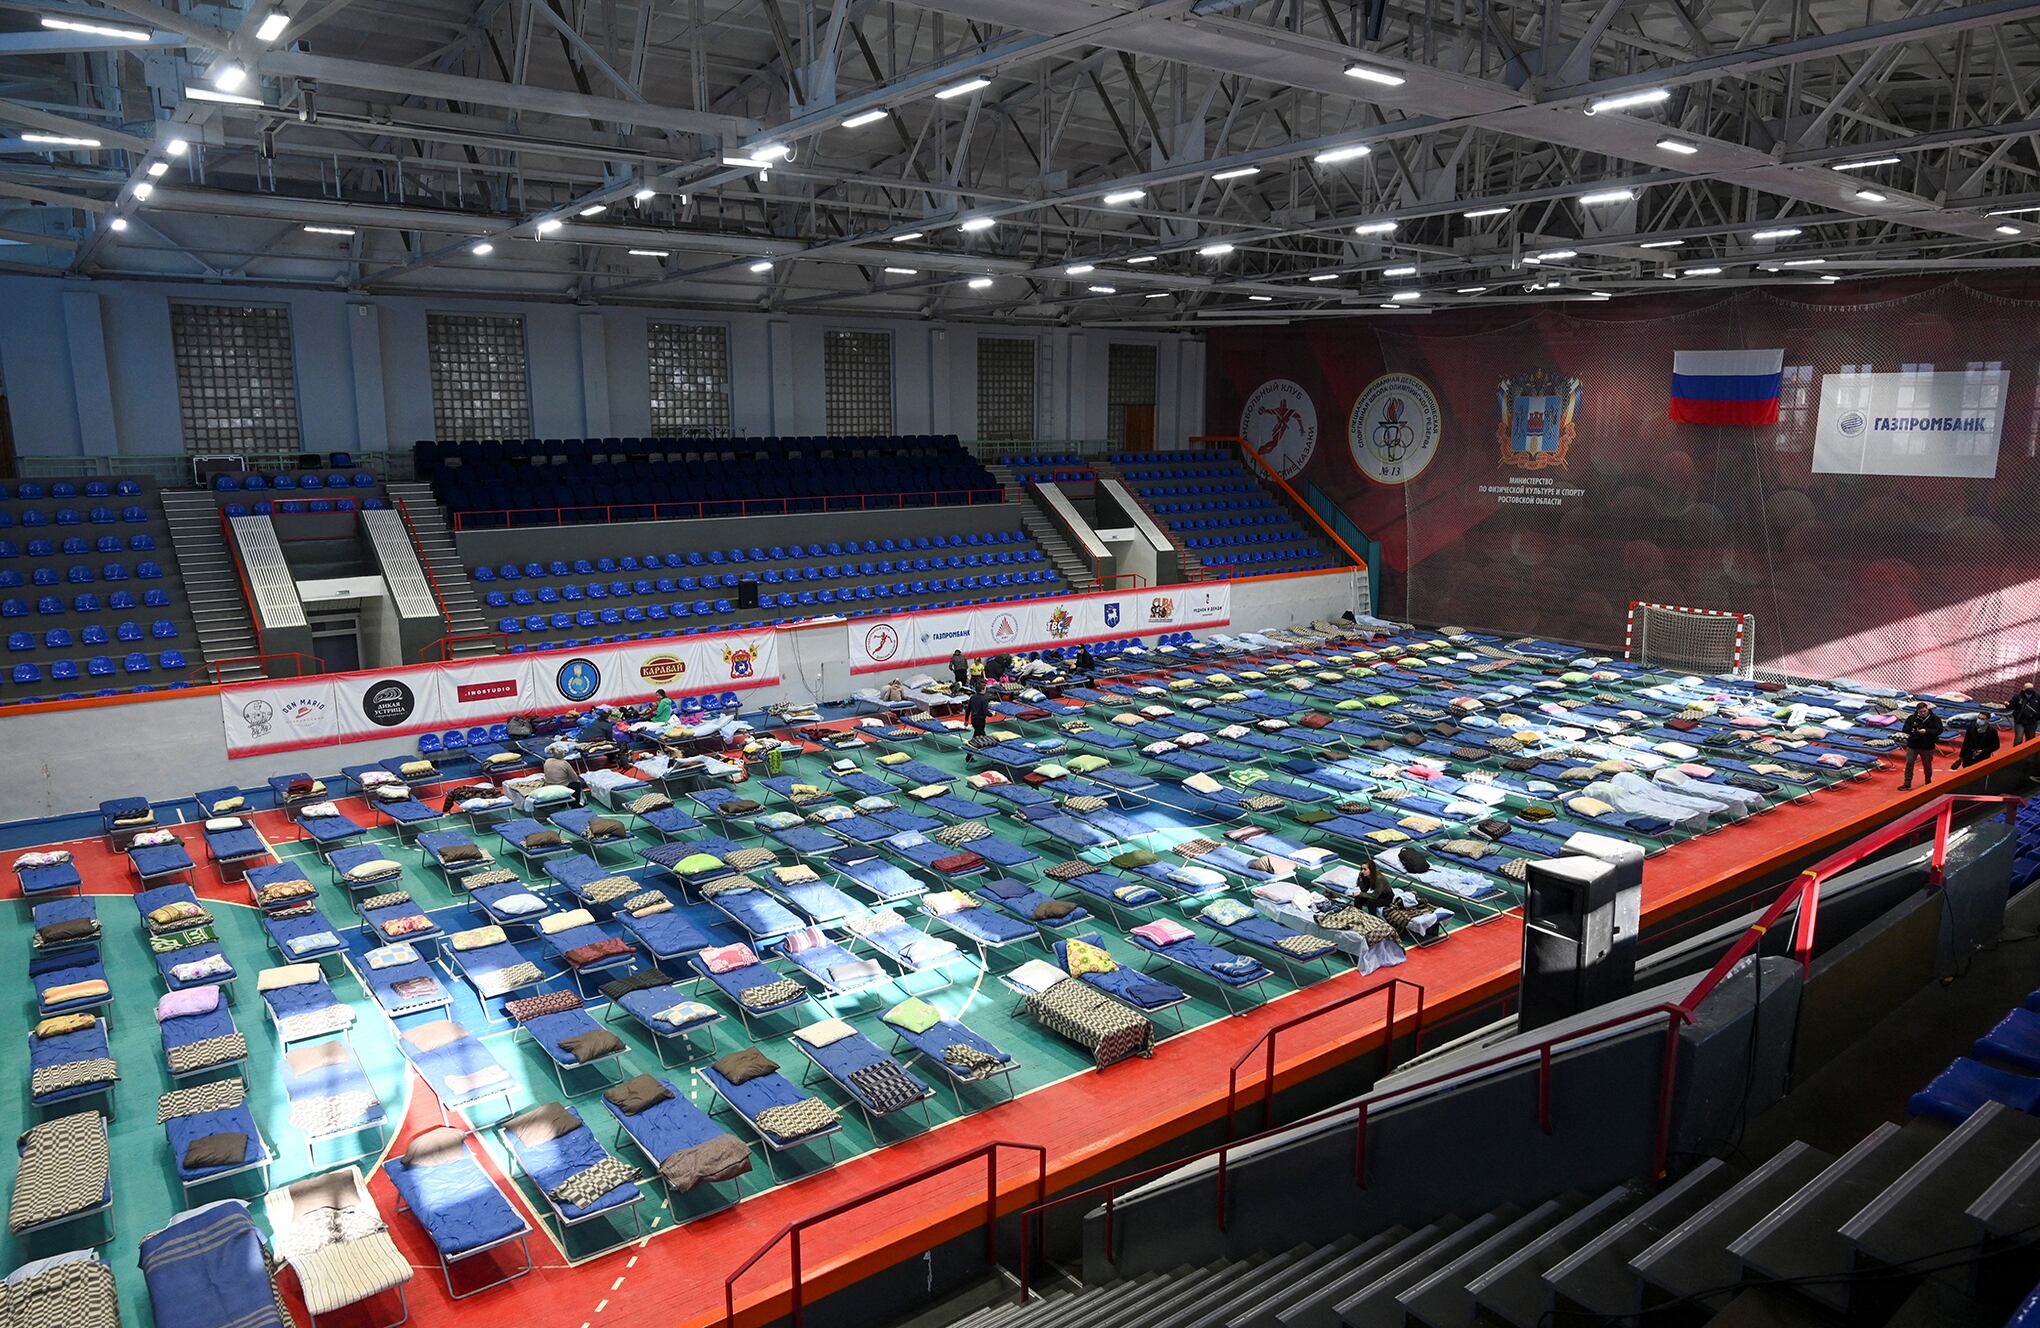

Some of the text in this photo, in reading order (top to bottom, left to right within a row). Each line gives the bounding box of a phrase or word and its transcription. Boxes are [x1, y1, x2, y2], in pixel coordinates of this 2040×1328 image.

[1242, 382, 1303, 441] АНДБОЛЬНЫЙ КЛУБ
[1351, 376, 1439, 434] СПЕЦИАЛИЗИРОВАННАЯ ДЕТСКО-ЮНОШЕСКАЯ
[1369, 386, 1388, 402] ШКОЛА
[1389, 384, 1430, 414] ОЛИМПИЙСКОГО
[1421, 417, 1431, 449] РЕЗЕРВА
[1874, 417, 1985, 431] ГАЗПРОМБАНК
[1297, 426, 1314, 468] КАЗАКИ
[1379, 466, 1401, 477] № 13
[1479, 485, 1487, 493] ПО
[1488, 485, 1524, 494] ФИЗИЧЕСКОЙ
[1525, 487, 1554, 495] КУЛЬТУРЕ
[1562, 489, 1585, 497] СПОРТУ
[1498, 496, 1562, 506] РОСТОВСКОЙ ОБЛАСТИ
[933, 629, 970, 640] ГАЗПРОМБАНК
[642, 663, 683, 676] КАРАВАЙ
[282, 699, 325, 714] DON MARIO
[374, 707, 405, 715] УСТРИЦА
[378, 702, 400, 710] ДИКАЯ
